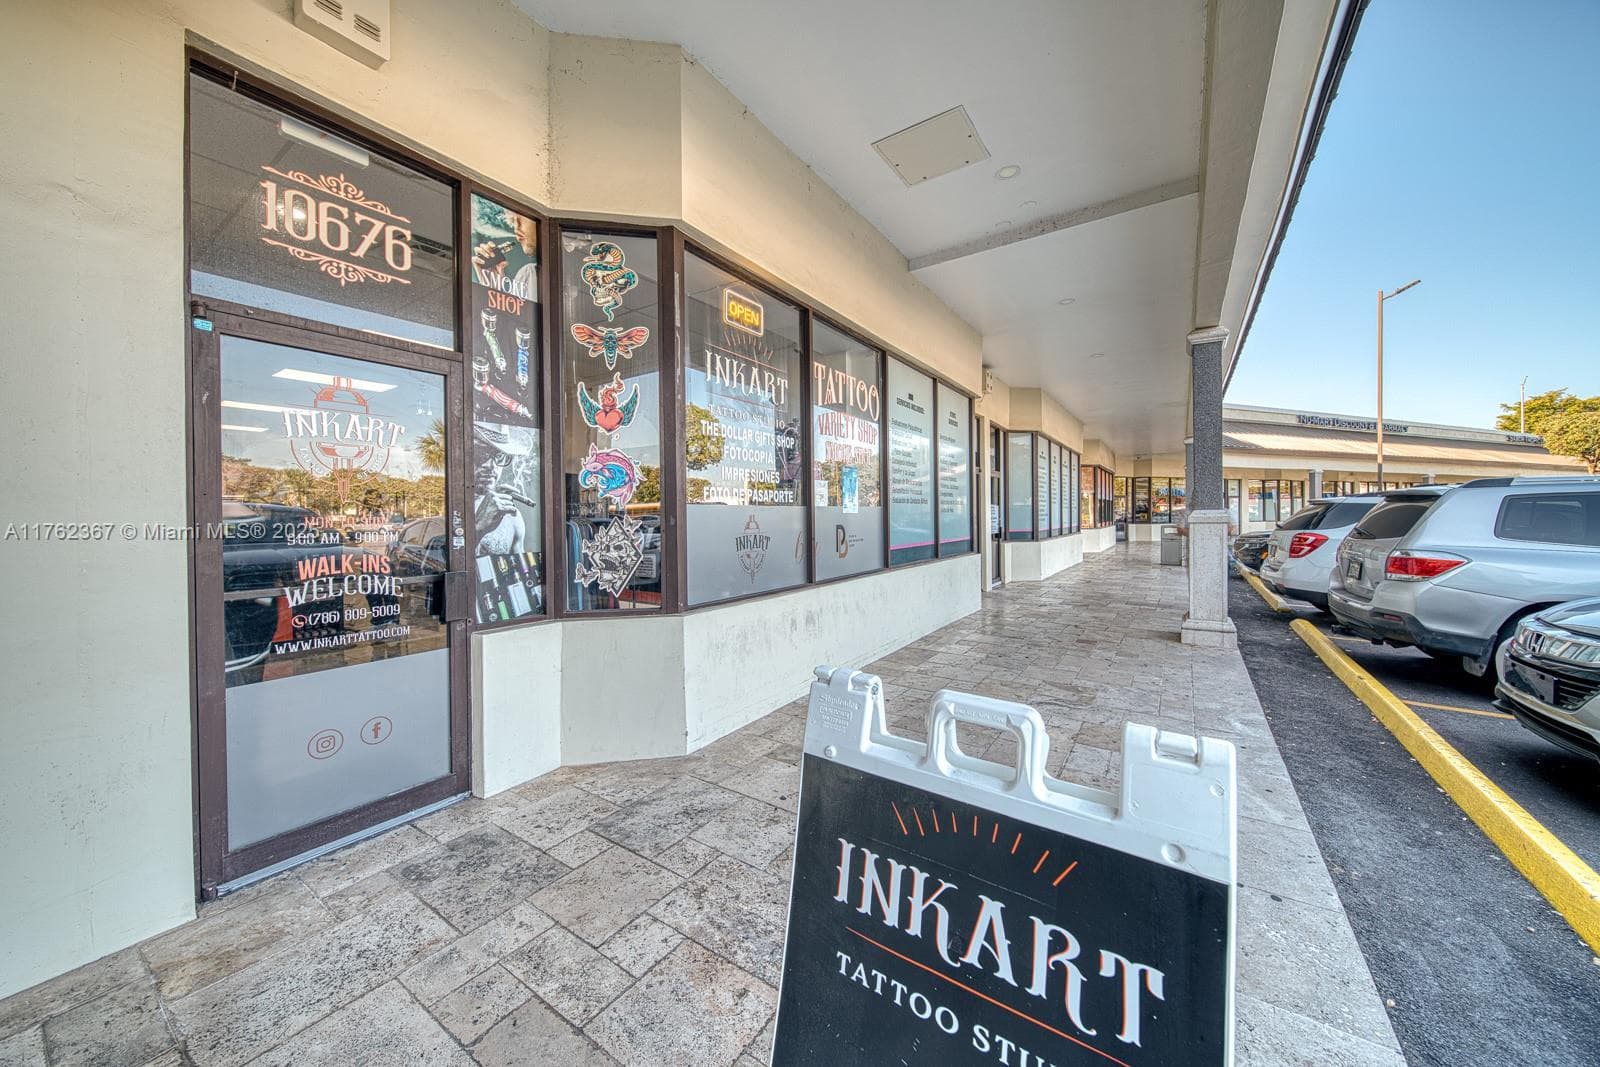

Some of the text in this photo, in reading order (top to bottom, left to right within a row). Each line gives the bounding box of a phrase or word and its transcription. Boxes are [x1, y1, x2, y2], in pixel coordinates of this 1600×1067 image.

[259, 180, 413, 271] 10676
[481, 269, 528, 298] SMOKE
[488, 290, 525, 316] SHOP
[729, 301, 759, 326] OPEN
[705, 350, 788, 406] INKART
[814, 362, 879, 421] TATTOO
[281, 408, 406, 449] INKART
[701, 420, 795, 449] THE DOLLAR GIFTS SHOP
[818, 411, 856, 440] VARIETY
[858, 422, 878, 445] SHOP
[724, 446, 774, 464] FOTOCOPIA
[722, 467, 780, 484] IMPRESIONES
[703, 487, 794, 503] FOTO DE PASAPORTE
[304, 516, 334, 529] MON
[341, 516, 355, 528] TO
[320, 532, 340, 545] AM
[382, 531, 399, 543] PM
[736, 534, 771, 552] INKART
[298, 554, 391, 580] WALK-INS
[284, 574, 404, 608] WELCOME
[308, 604, 401, 626] (786) 809-5009
[275, 625, 411, 655] WWW.INKARTTATTOO.COM
[833, 838, 1166, 1048] INKART
[836, 951, 1056, 1067] TATTOO STU
